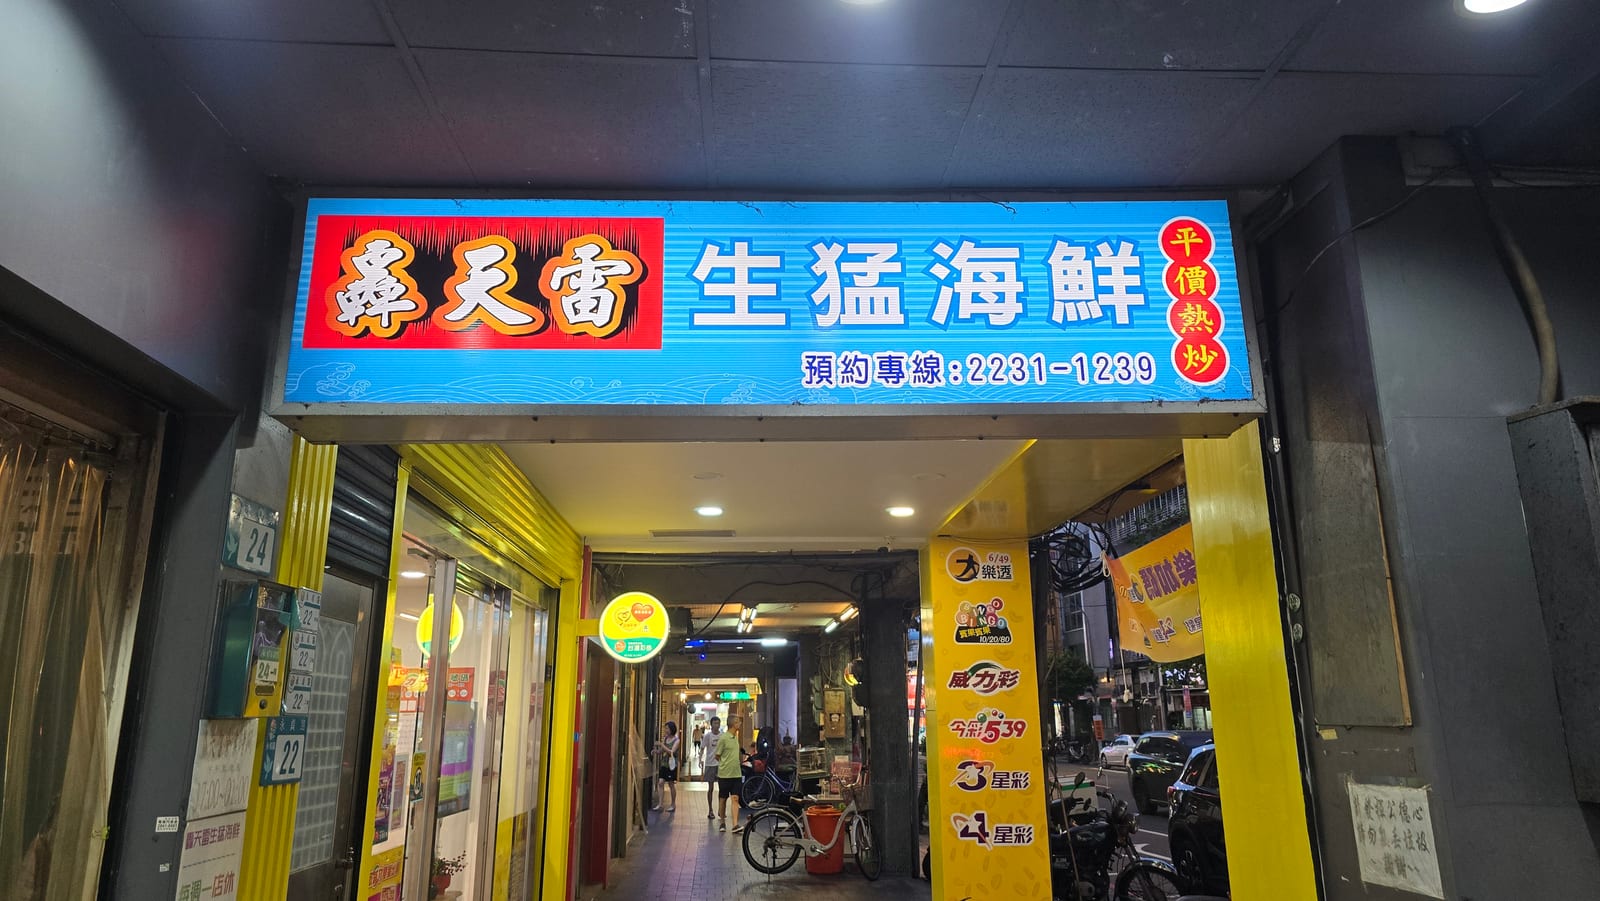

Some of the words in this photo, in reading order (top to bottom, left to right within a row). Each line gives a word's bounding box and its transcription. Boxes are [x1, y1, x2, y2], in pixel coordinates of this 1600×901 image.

[333, 236, 635, 330] 轟天雷
[692, 238, 1145, 328] 生猛海鮮
[1168, 225, 1219, 379] 平價熱炒
[803, 351, 1154, 387] 預約專線:2231-1239
[245, 527, 269, 566] 24
[988, 553, 1009, 563] 6/49
[302, 609, 313, 626] 22
[958, 613, 1006, 628] BINGO
[979, 635, 1010, 643] 10/20/80
[298, 651, 309, 667] 22
[948, 670, 1020, 691] 威力彩
[292, 694, 303, 710] 22
[950, 720, 1026, 743] 今彩539
[279, 740, 299, 775] 22
[956, 761, 1030, 791] 3星彩
[959, 813, 1033, 844] 4星彩
